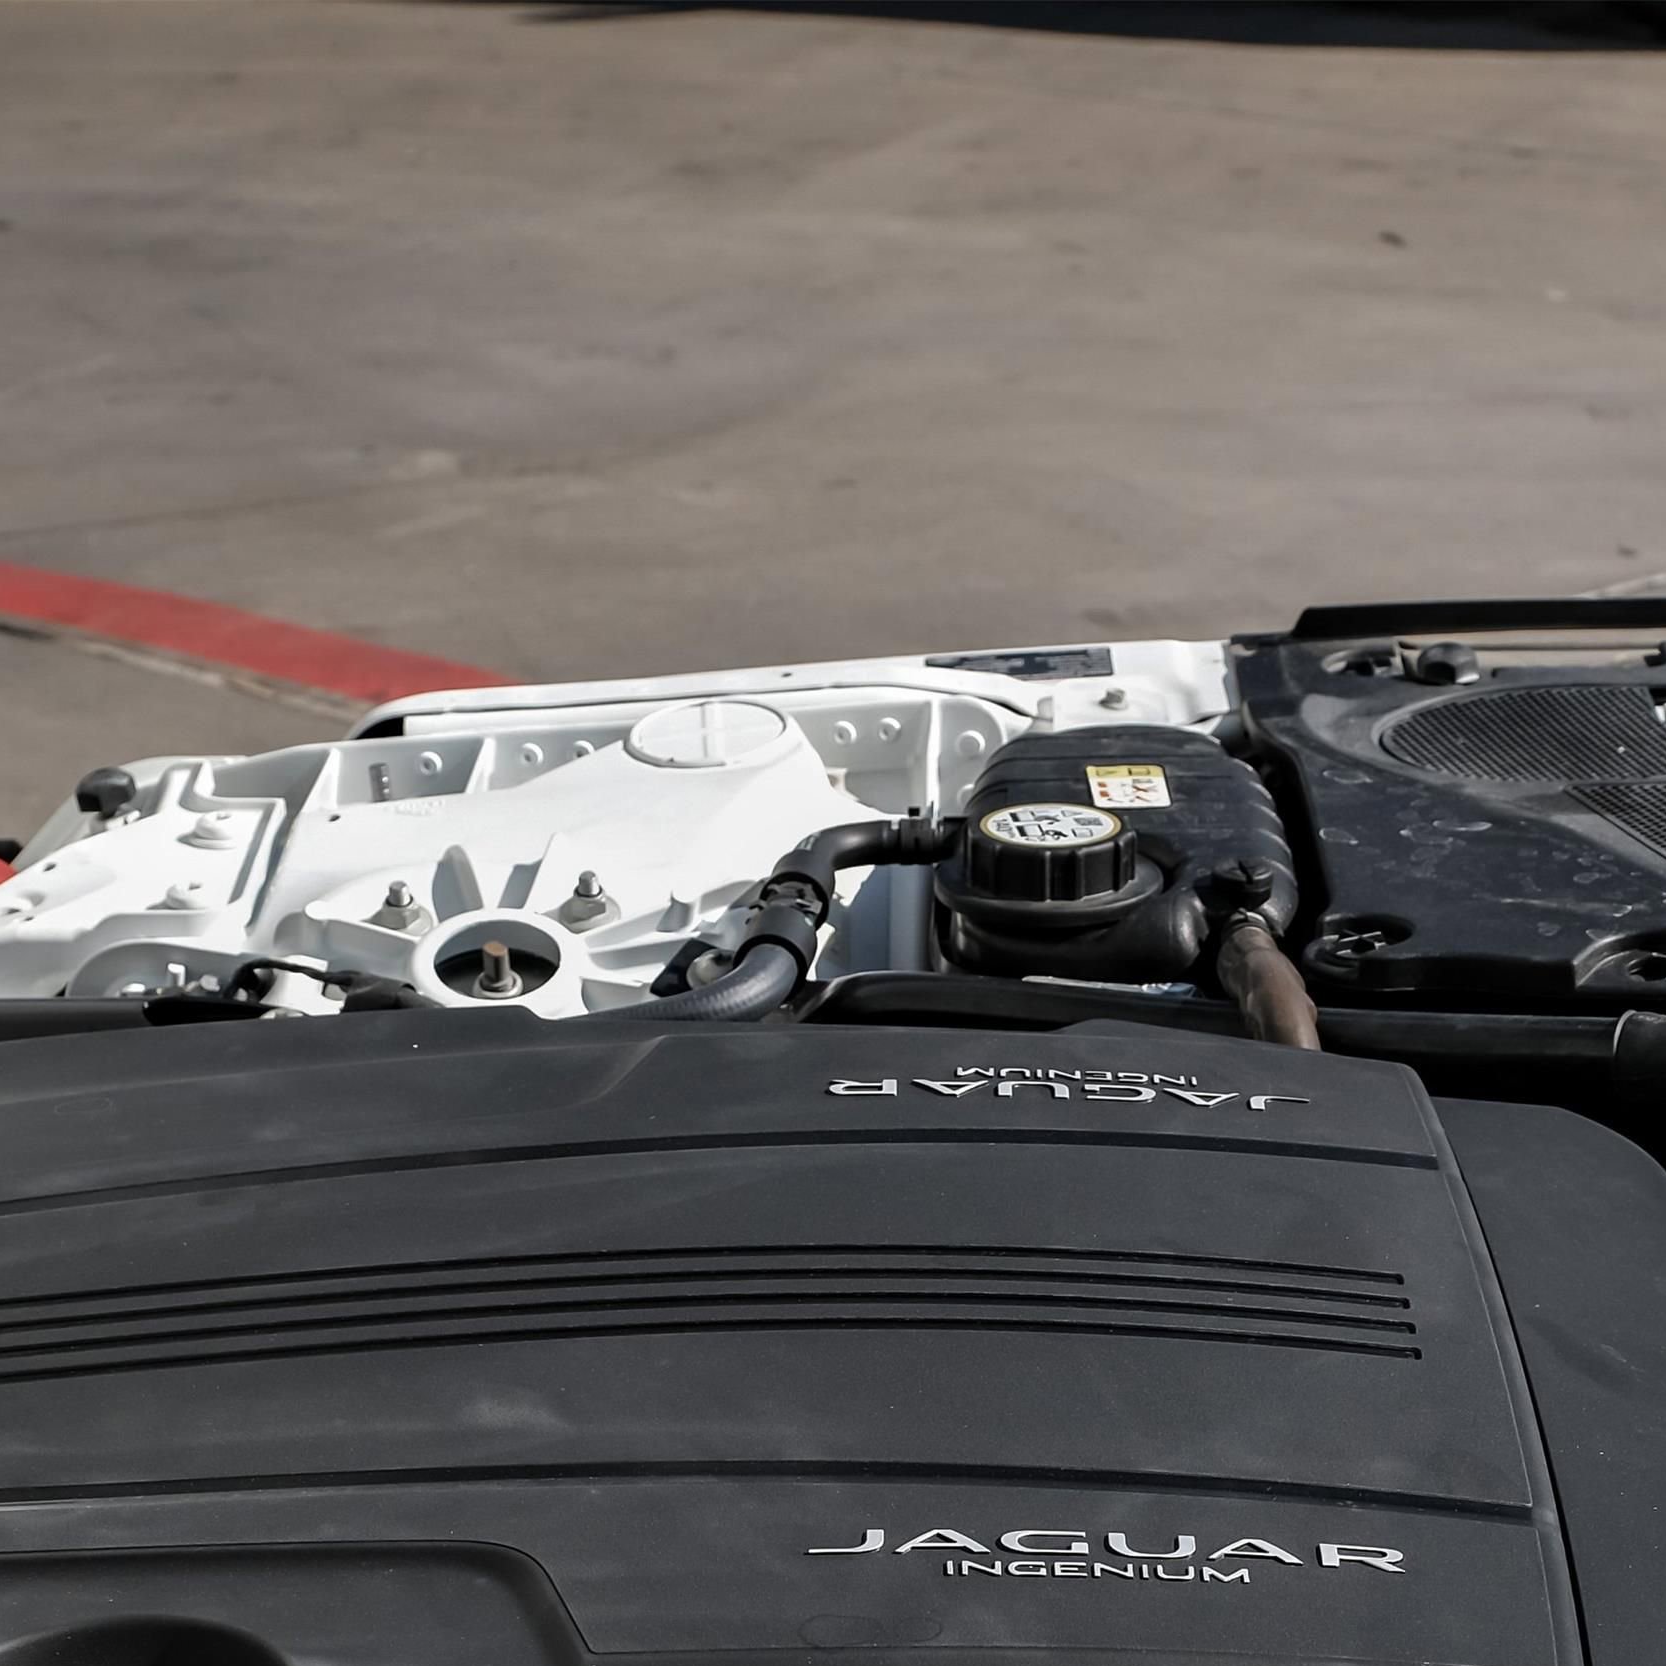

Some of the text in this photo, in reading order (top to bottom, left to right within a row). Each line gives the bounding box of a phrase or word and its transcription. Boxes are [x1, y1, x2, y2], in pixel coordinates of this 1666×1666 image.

[955, 1065, 1200, 1087] INGENIUM
[827, 1077, 1312, 1113] JAGUAR
[805, 1527, 1408, 1576] JAGUAR
[944, 1559, 1253, 1585] INGENIUM
